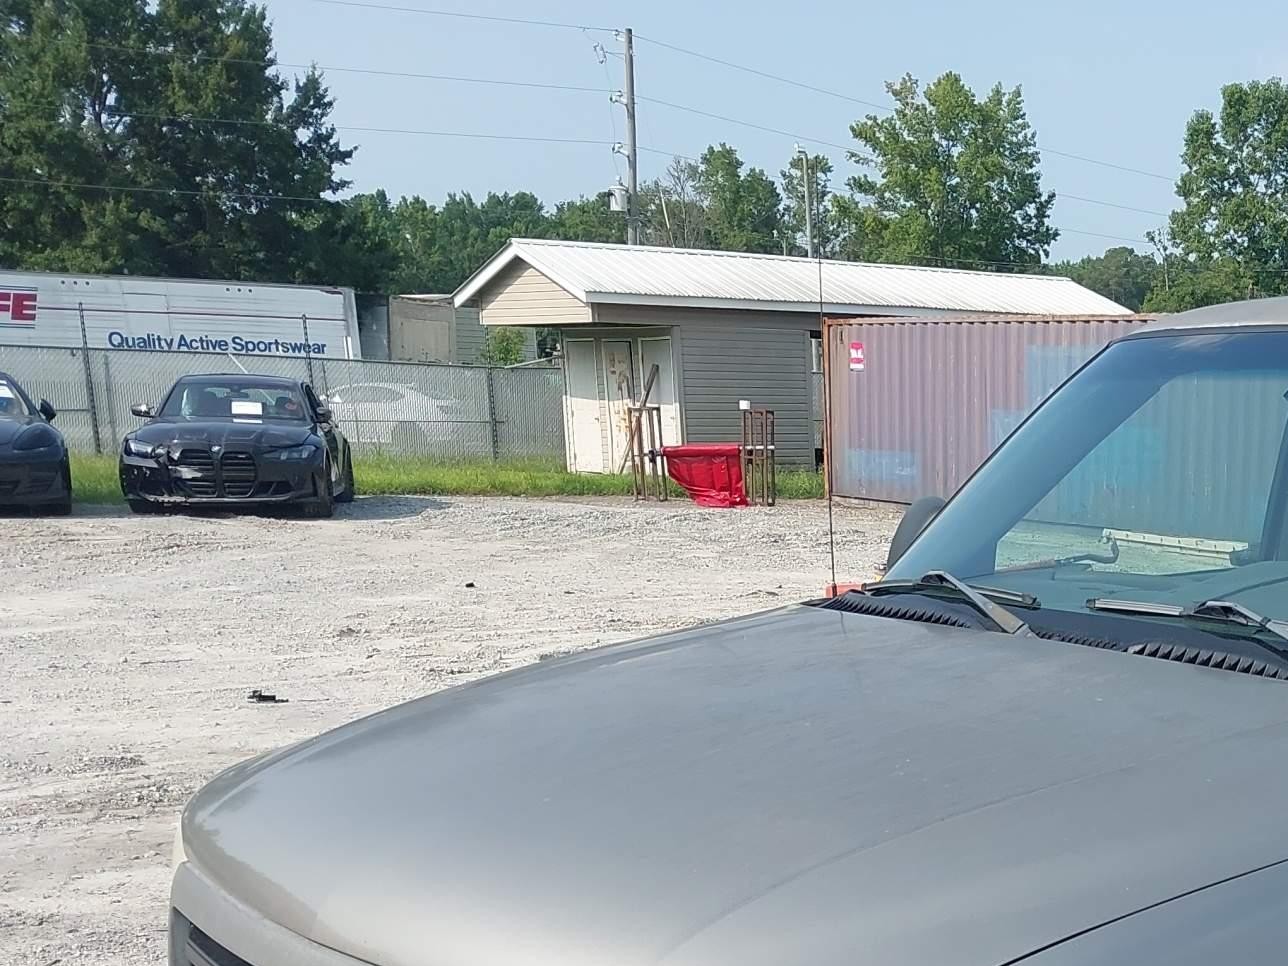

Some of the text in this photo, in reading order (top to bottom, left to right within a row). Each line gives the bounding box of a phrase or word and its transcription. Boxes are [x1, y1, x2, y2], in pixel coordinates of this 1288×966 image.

[108, 332, 327, 355] Quality Active Sportswear
